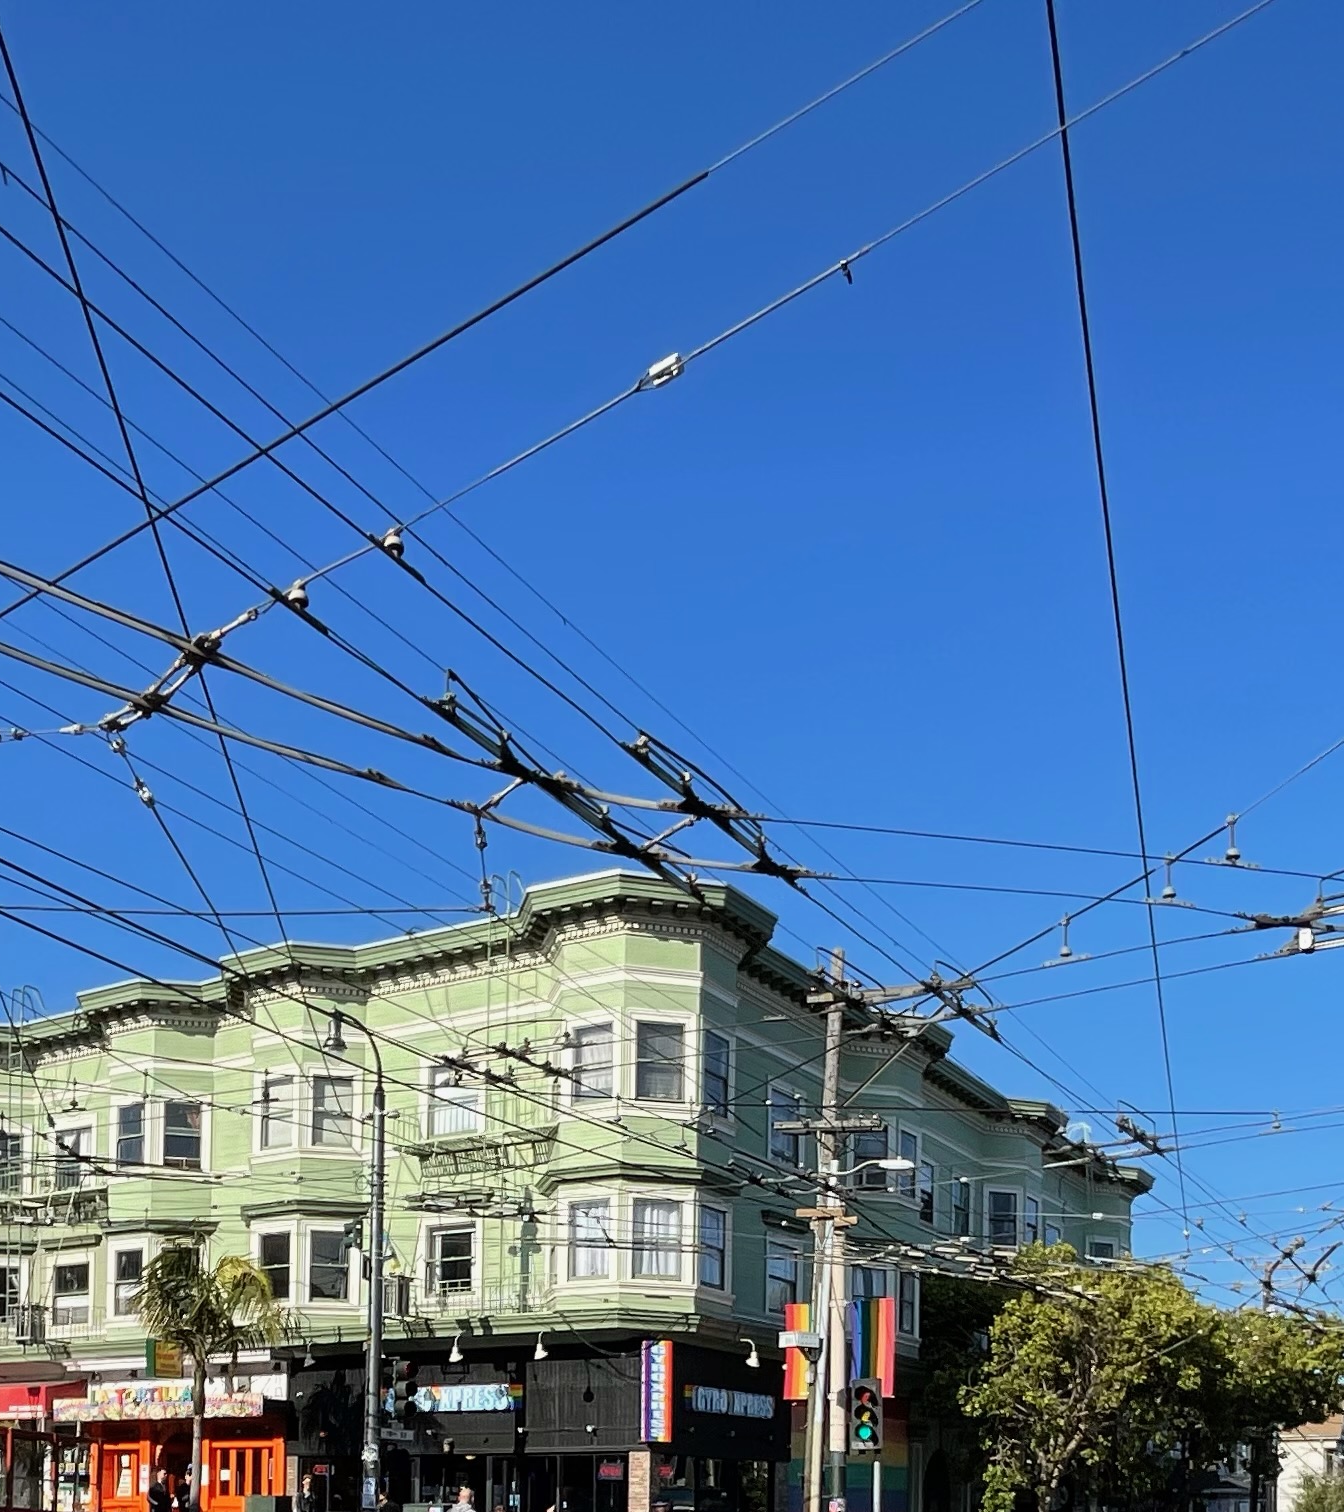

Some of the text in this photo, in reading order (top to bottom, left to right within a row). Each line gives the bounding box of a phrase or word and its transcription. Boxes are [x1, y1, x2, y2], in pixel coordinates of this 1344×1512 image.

[439, 1385, 508, 1411] XPRESS
[697, 1386, 774, 1418] GYRO XPRESS
